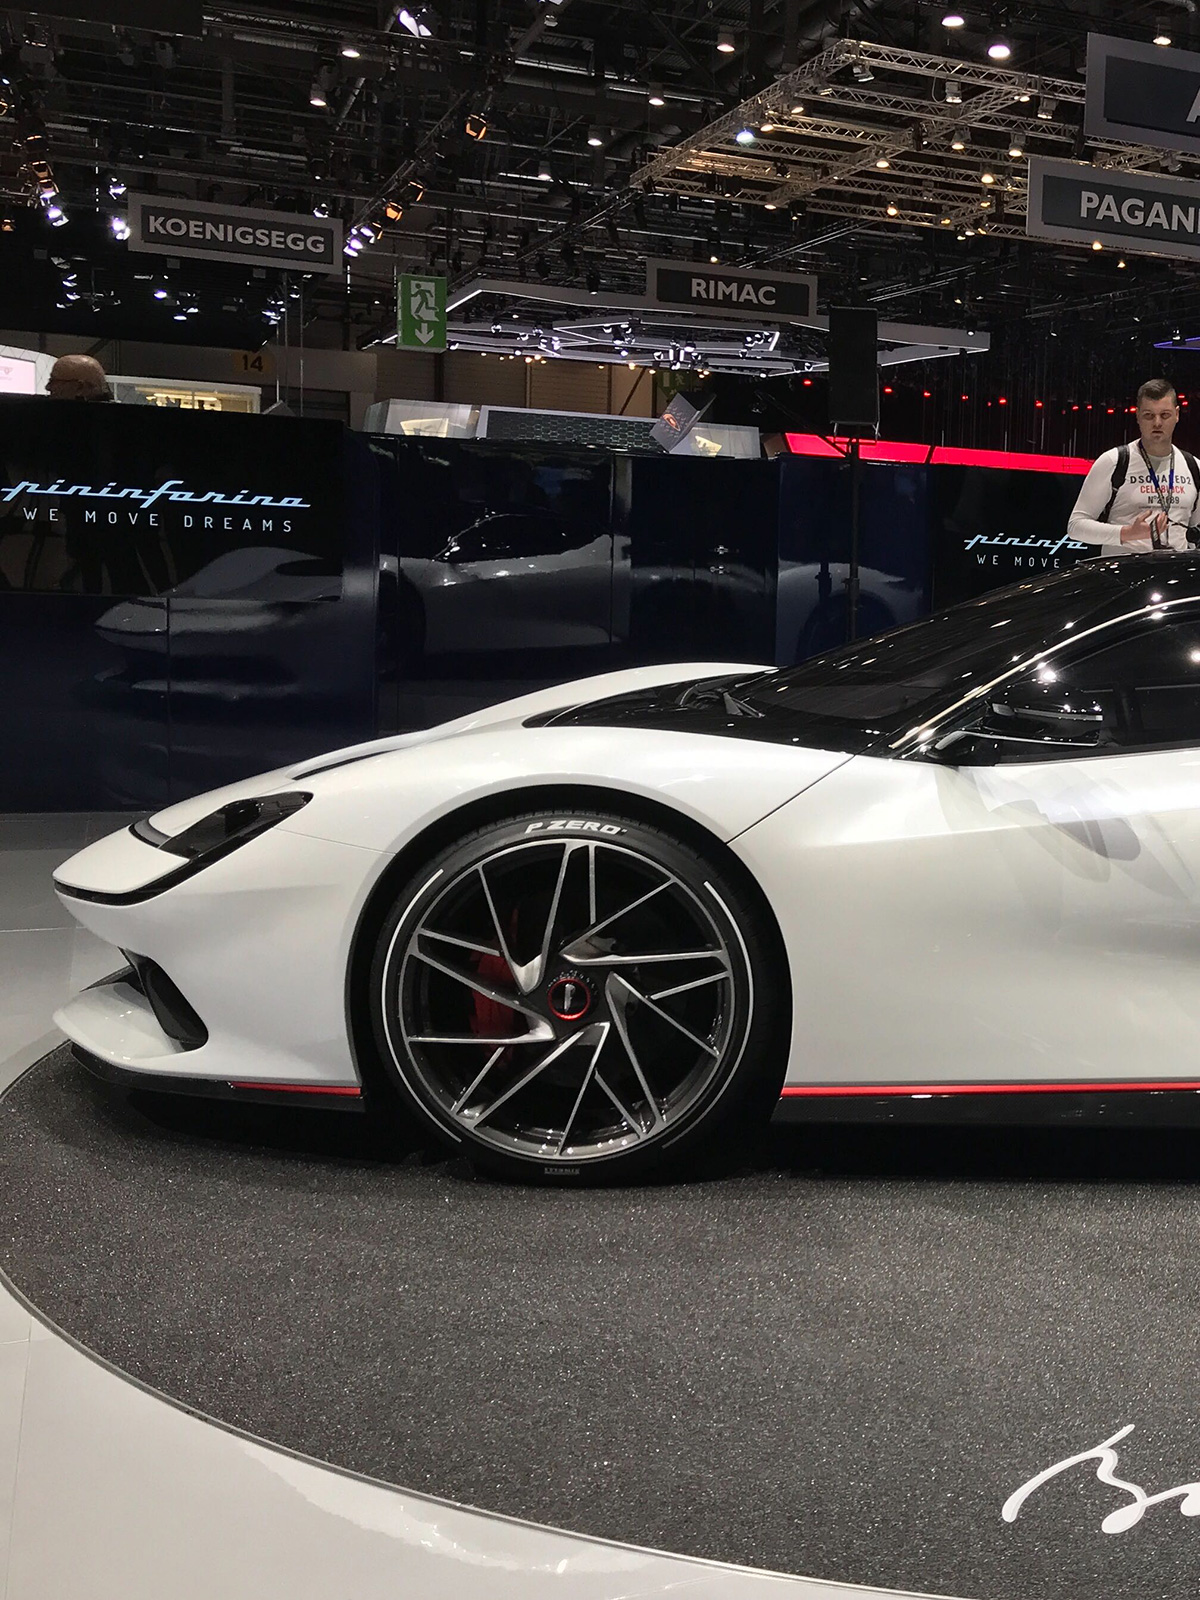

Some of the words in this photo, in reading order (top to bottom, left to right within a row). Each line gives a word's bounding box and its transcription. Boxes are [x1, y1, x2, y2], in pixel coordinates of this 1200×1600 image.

[149, 215, 325, 253] KOENIGSEGG
[691, 278, 776, 306] RIMAC
[241, 353, 264, 372] 14
[1, 479, 311, 509] pininfarina
[23, 507, 59, 522] WE
[85, 510, 159, 526] MOVE
[184, 515, 292, 532] DREAMS
[963, 532, 1088, 555] pininfa
[976, 554, 999, 565] WE
[1014, 556, 1060, 569] MOVE
[524, 821, 544, 834] P
[547, 820, 621, 835] ZERO
